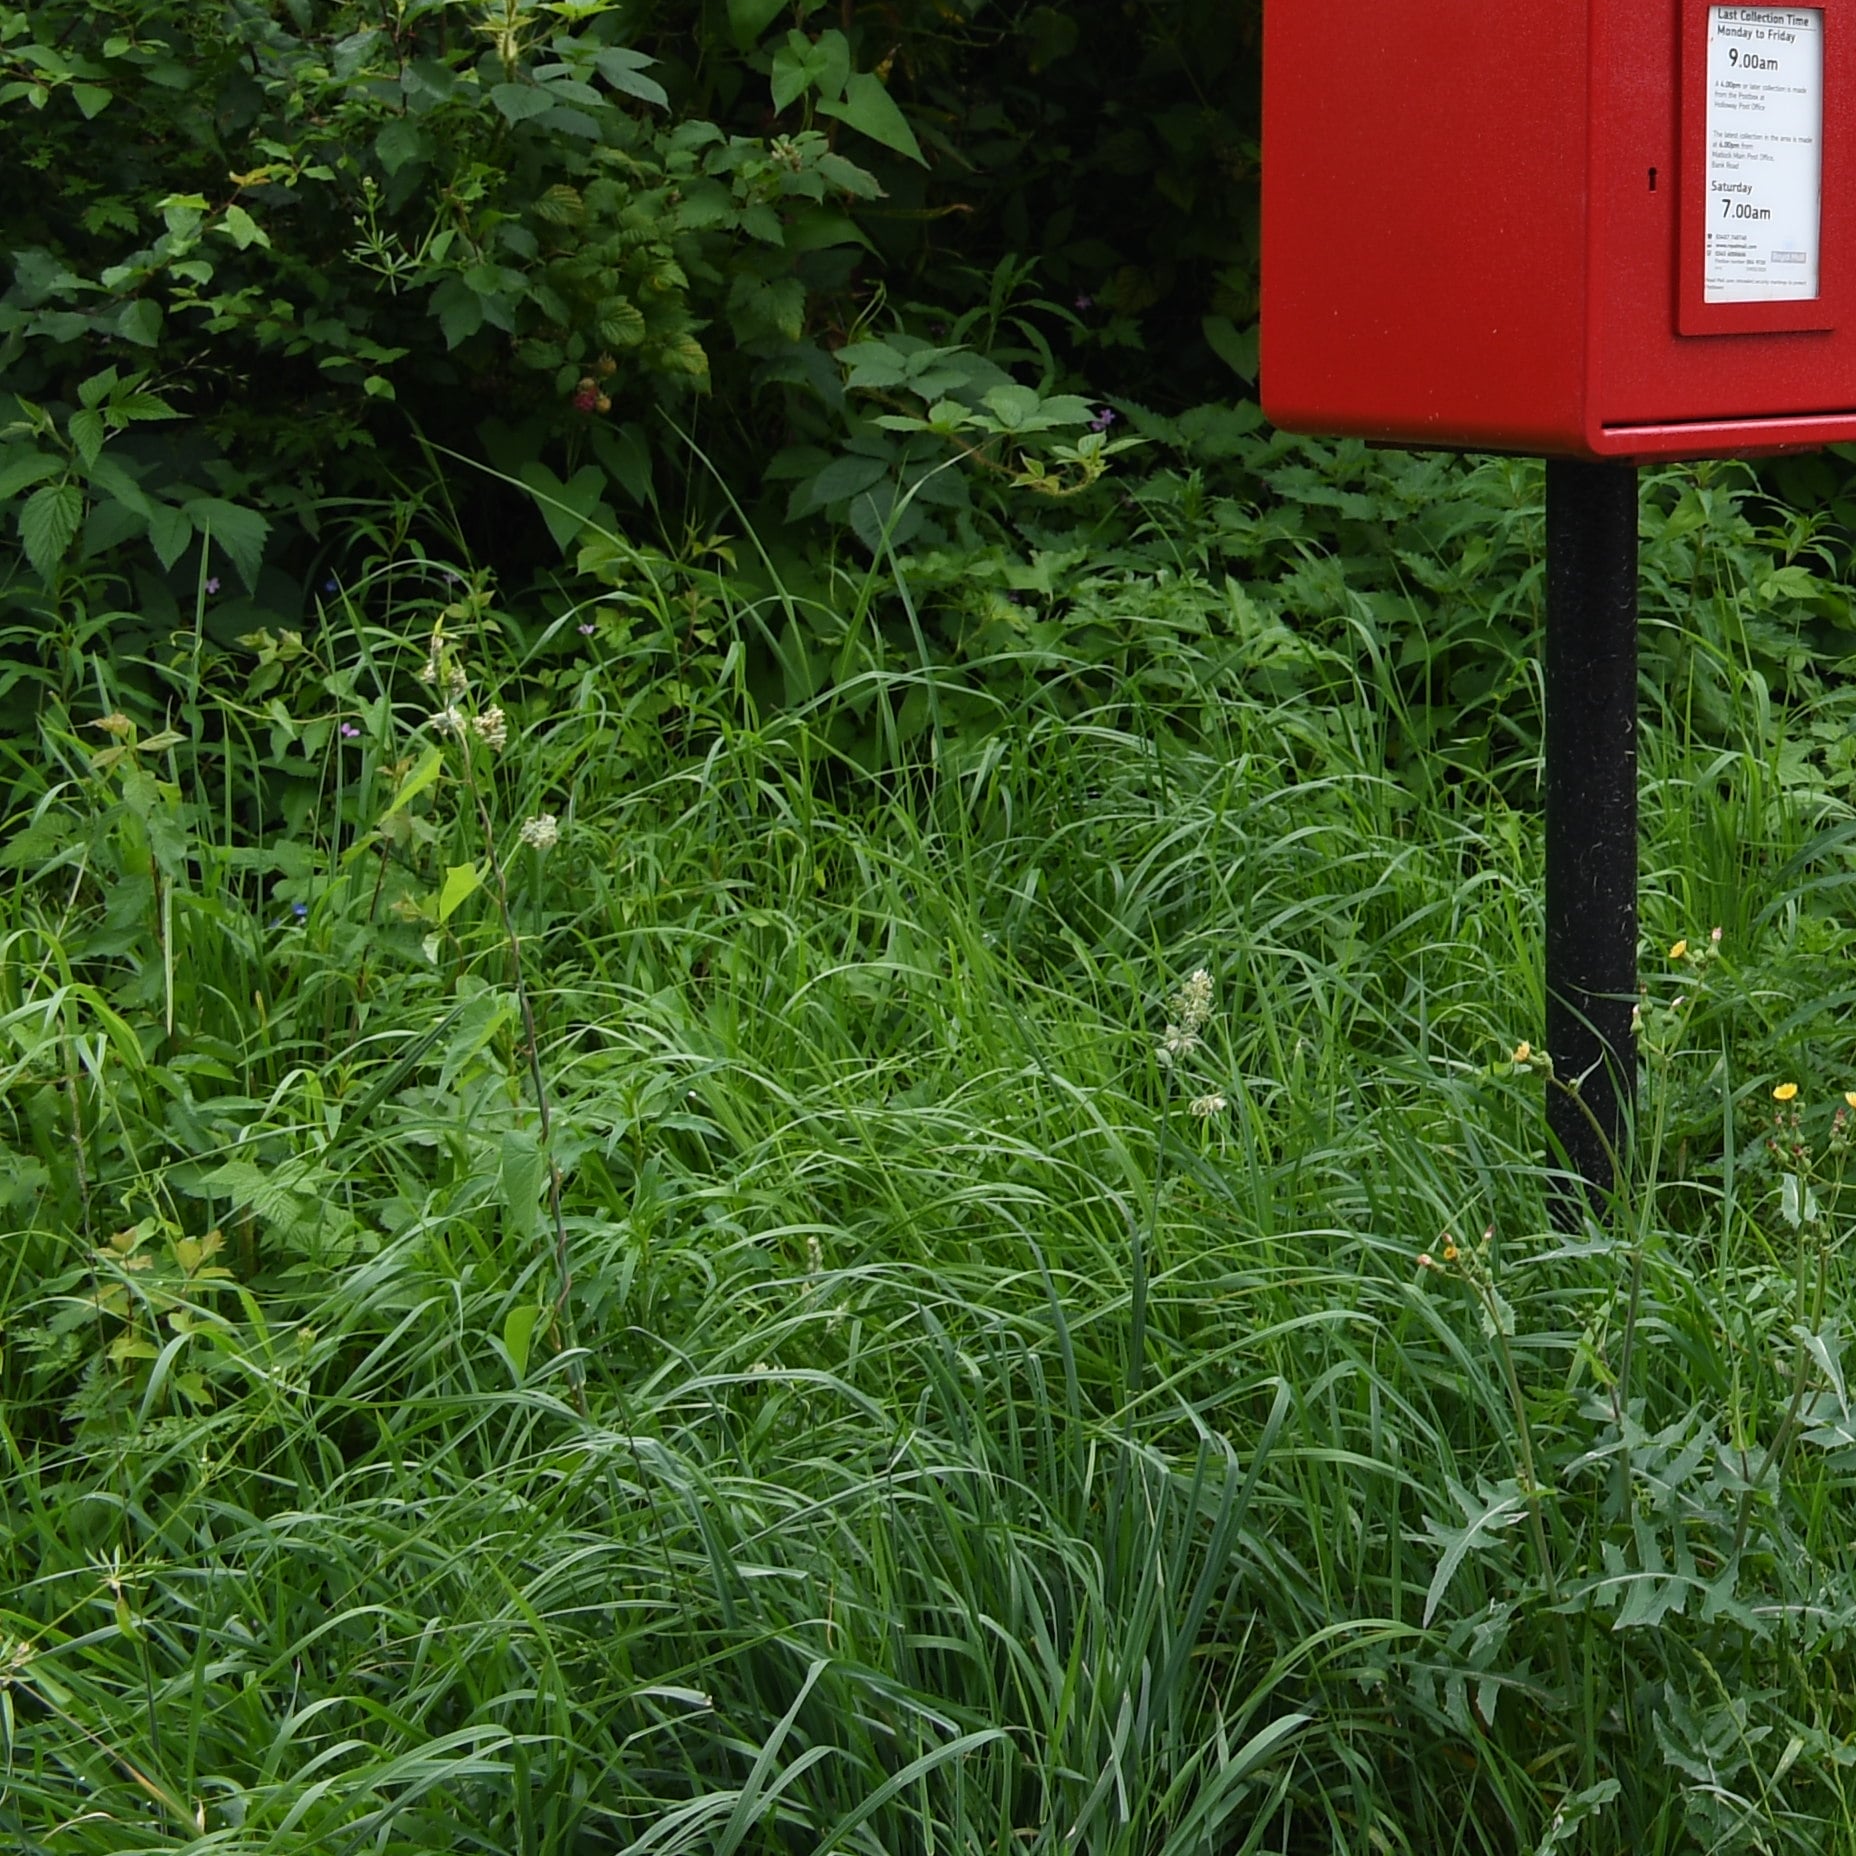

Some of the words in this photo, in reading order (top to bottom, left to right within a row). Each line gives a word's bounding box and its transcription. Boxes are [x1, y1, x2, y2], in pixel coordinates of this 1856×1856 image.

[1718, 8, 1737, 20] Last
[1740, 9, 1784, 25] Collection
[1787, 14, 1809, 26] Time
[1717, 25, 1752, 40] Monday
[1756, 29, 1764, 39] to
[1768, 29, 1796, 44] Friday
[1729, 48, 1778, 70] 9.00am
[1712, 180, 1752, 195] Saturday
[1722, 199, 1770, 220] 7.00am
